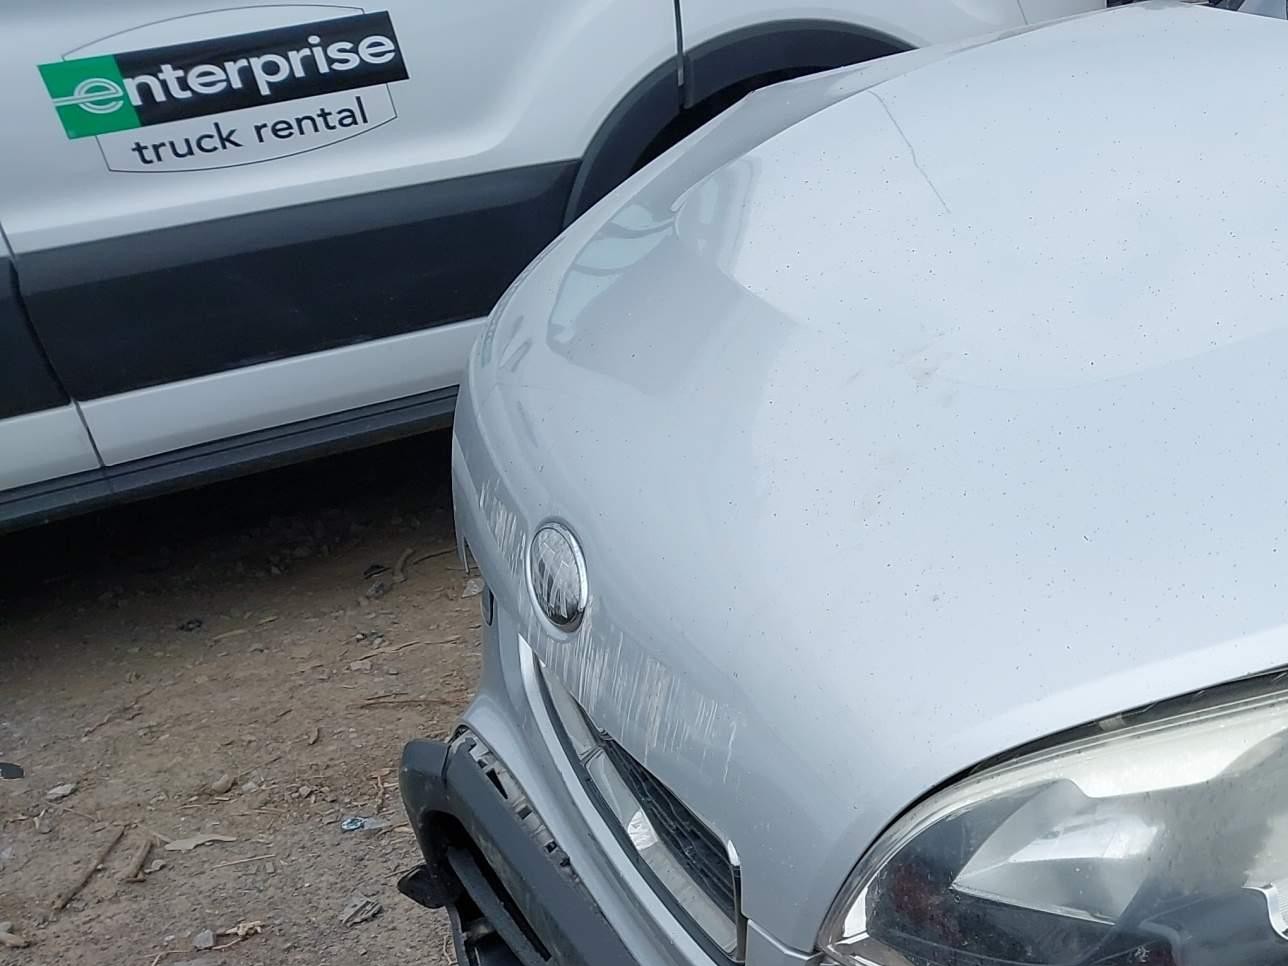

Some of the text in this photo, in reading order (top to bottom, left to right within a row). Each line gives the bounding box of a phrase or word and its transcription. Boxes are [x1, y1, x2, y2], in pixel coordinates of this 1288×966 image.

[54, 34, 397, 114] enterprise
[131, 96, 369, 165] truck rental
